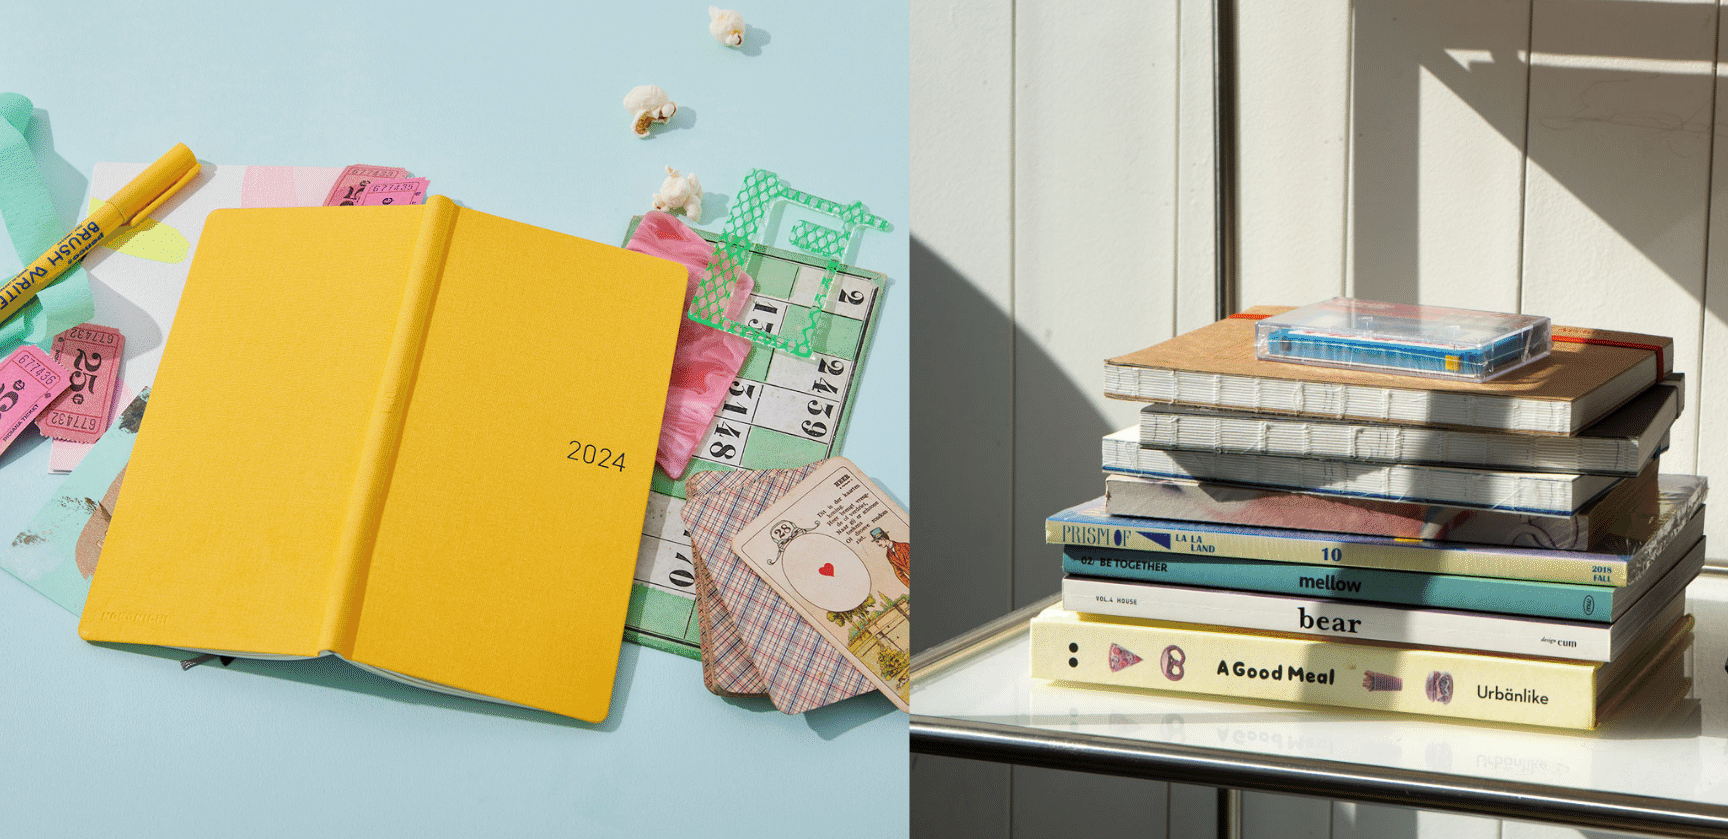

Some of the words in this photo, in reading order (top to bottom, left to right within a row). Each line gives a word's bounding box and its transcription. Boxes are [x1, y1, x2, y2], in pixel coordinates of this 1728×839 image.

[47, 221, 101, 266] BRUSH
[838, 289, 864, 306] 2
[70, 328, 114, 344] 677432
[18, 354, 57, 385] 677436
[812, 358, 845, 395] 24
[721, 380, 756, 416] 31
[51, 411, 96, 430] 677432
[801, 399, 834, 438] 39
[709, 420, 742, 460] 48
[567, 440, 626, 472] 2024
[773, 523, 792, 539] 28
[1062, 524, 1110, 546] PRISM
[1113, 529, 1132, 547] OF
[1175, 533, 1187, 543] LA
[1190, 535, 1203, 544] LA
[1190, 544, 1216, 553] LAND
[1321, 547, 1342, 562] 10
[1100, 557, 1112, 568] BE
[1114, 558, 1168, 573] TOGETHER
[1591, 565, 1612, 574] 2018
[1299, 575, 1362, 594] mellow
[1593, 574, 1611, 582] FALL
[1095, 595, 1113, 603] VOL.4
[1117, 597, 1138, 605] HOUSE
[1298, 606, 1362, 634] bear
[1557, 639, 1577, 648] cum
[1217, 659, 1229, 676] A
[1233, 661, 1283, 681] Good
[1288, 665, 1335, 686] Meal
[1477, 684, 1549, 705] Urbänlike
